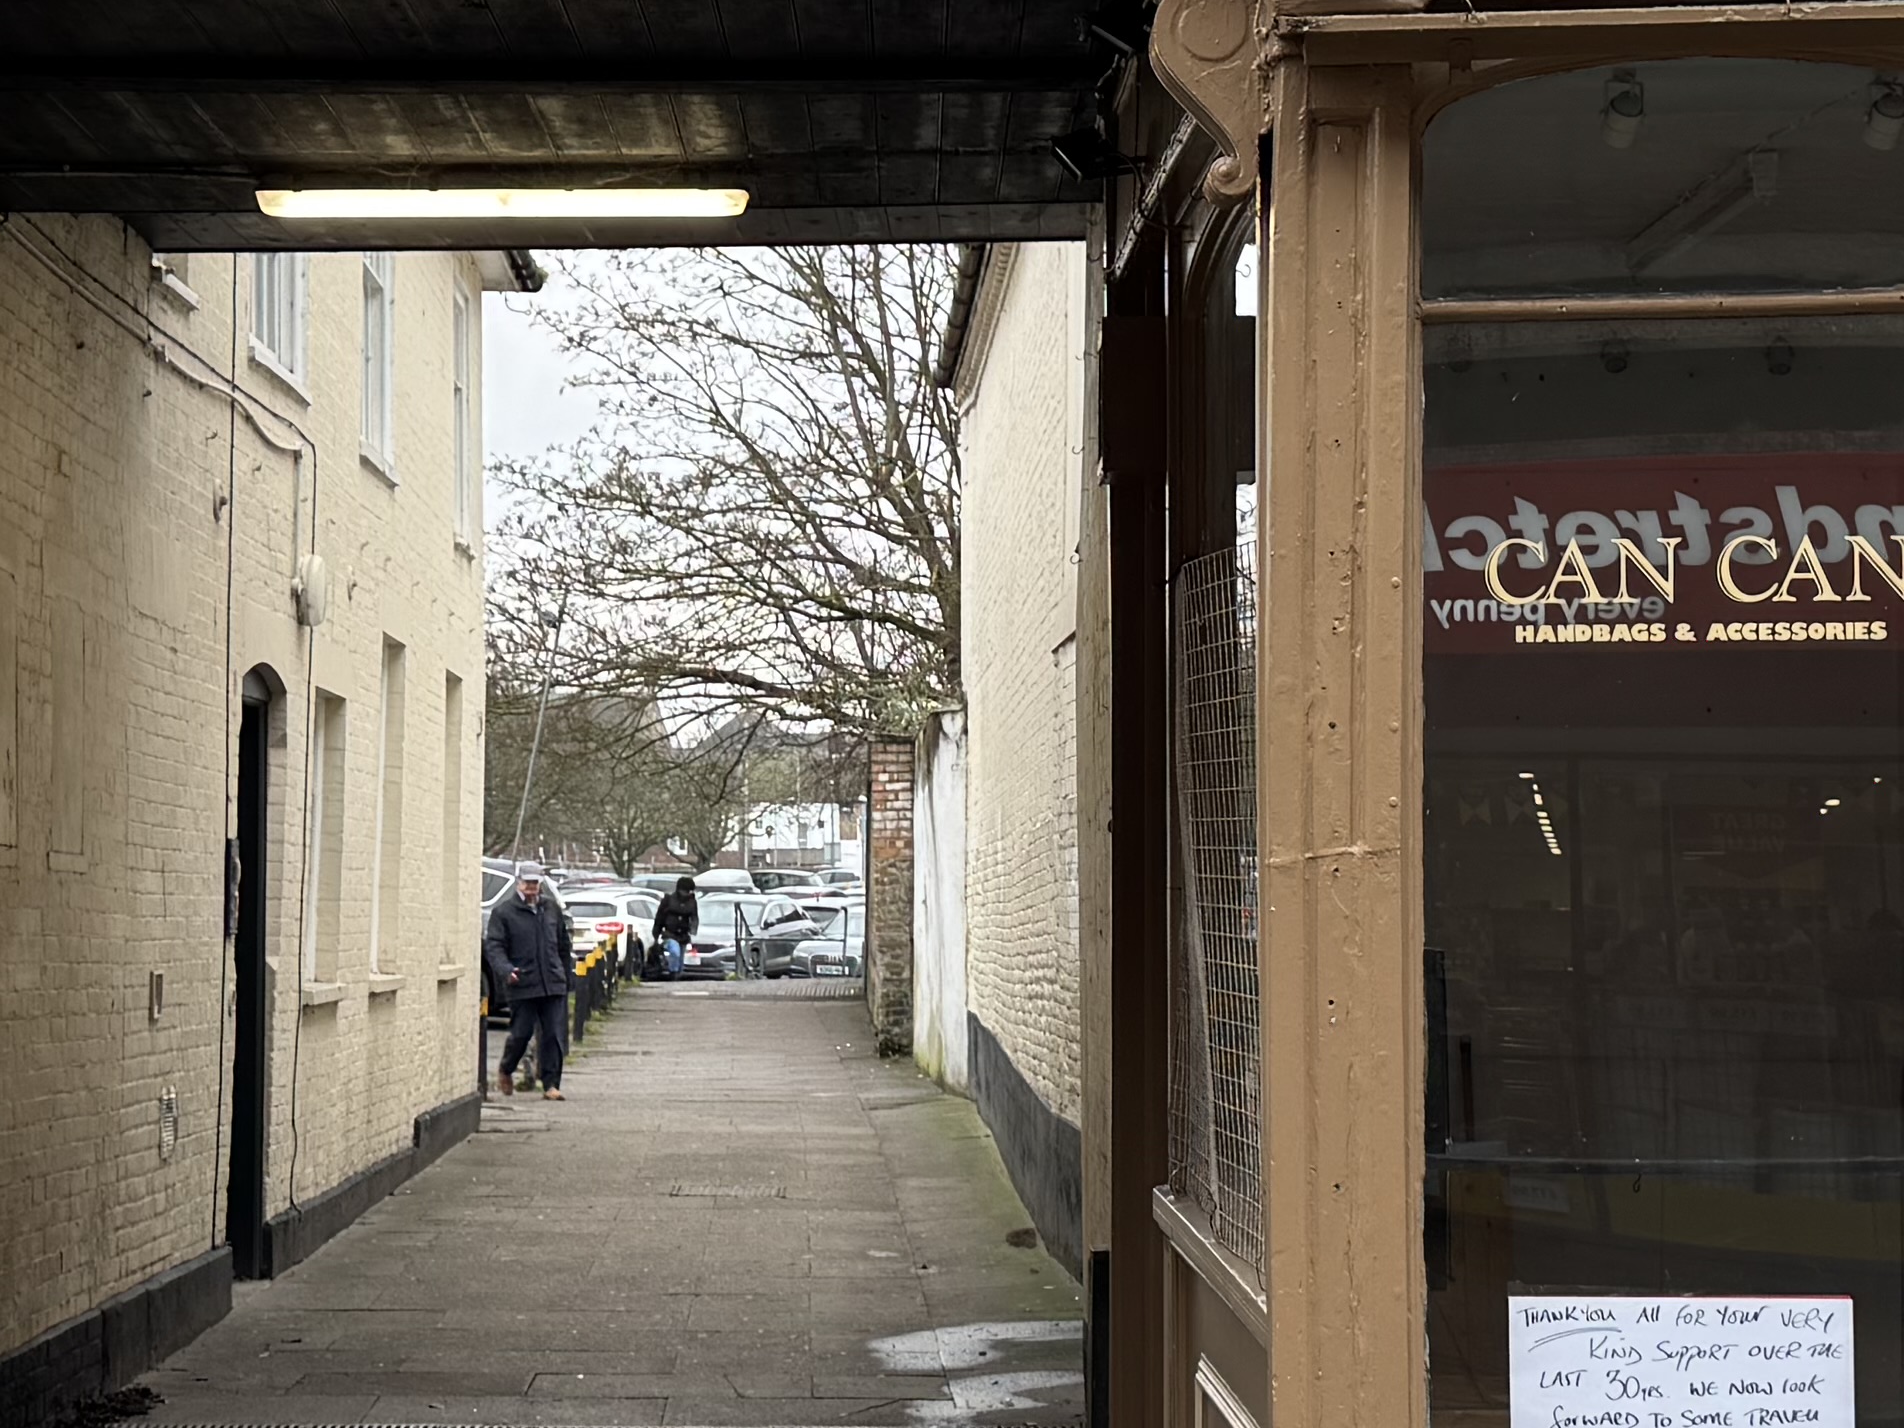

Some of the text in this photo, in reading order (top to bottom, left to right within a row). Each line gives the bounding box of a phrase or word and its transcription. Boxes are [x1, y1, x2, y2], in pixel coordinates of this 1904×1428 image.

[1484, 537, 1683, 605] CAN
[1515, 621, 1888, 643] HANDBAGS & ACCESSORIES
